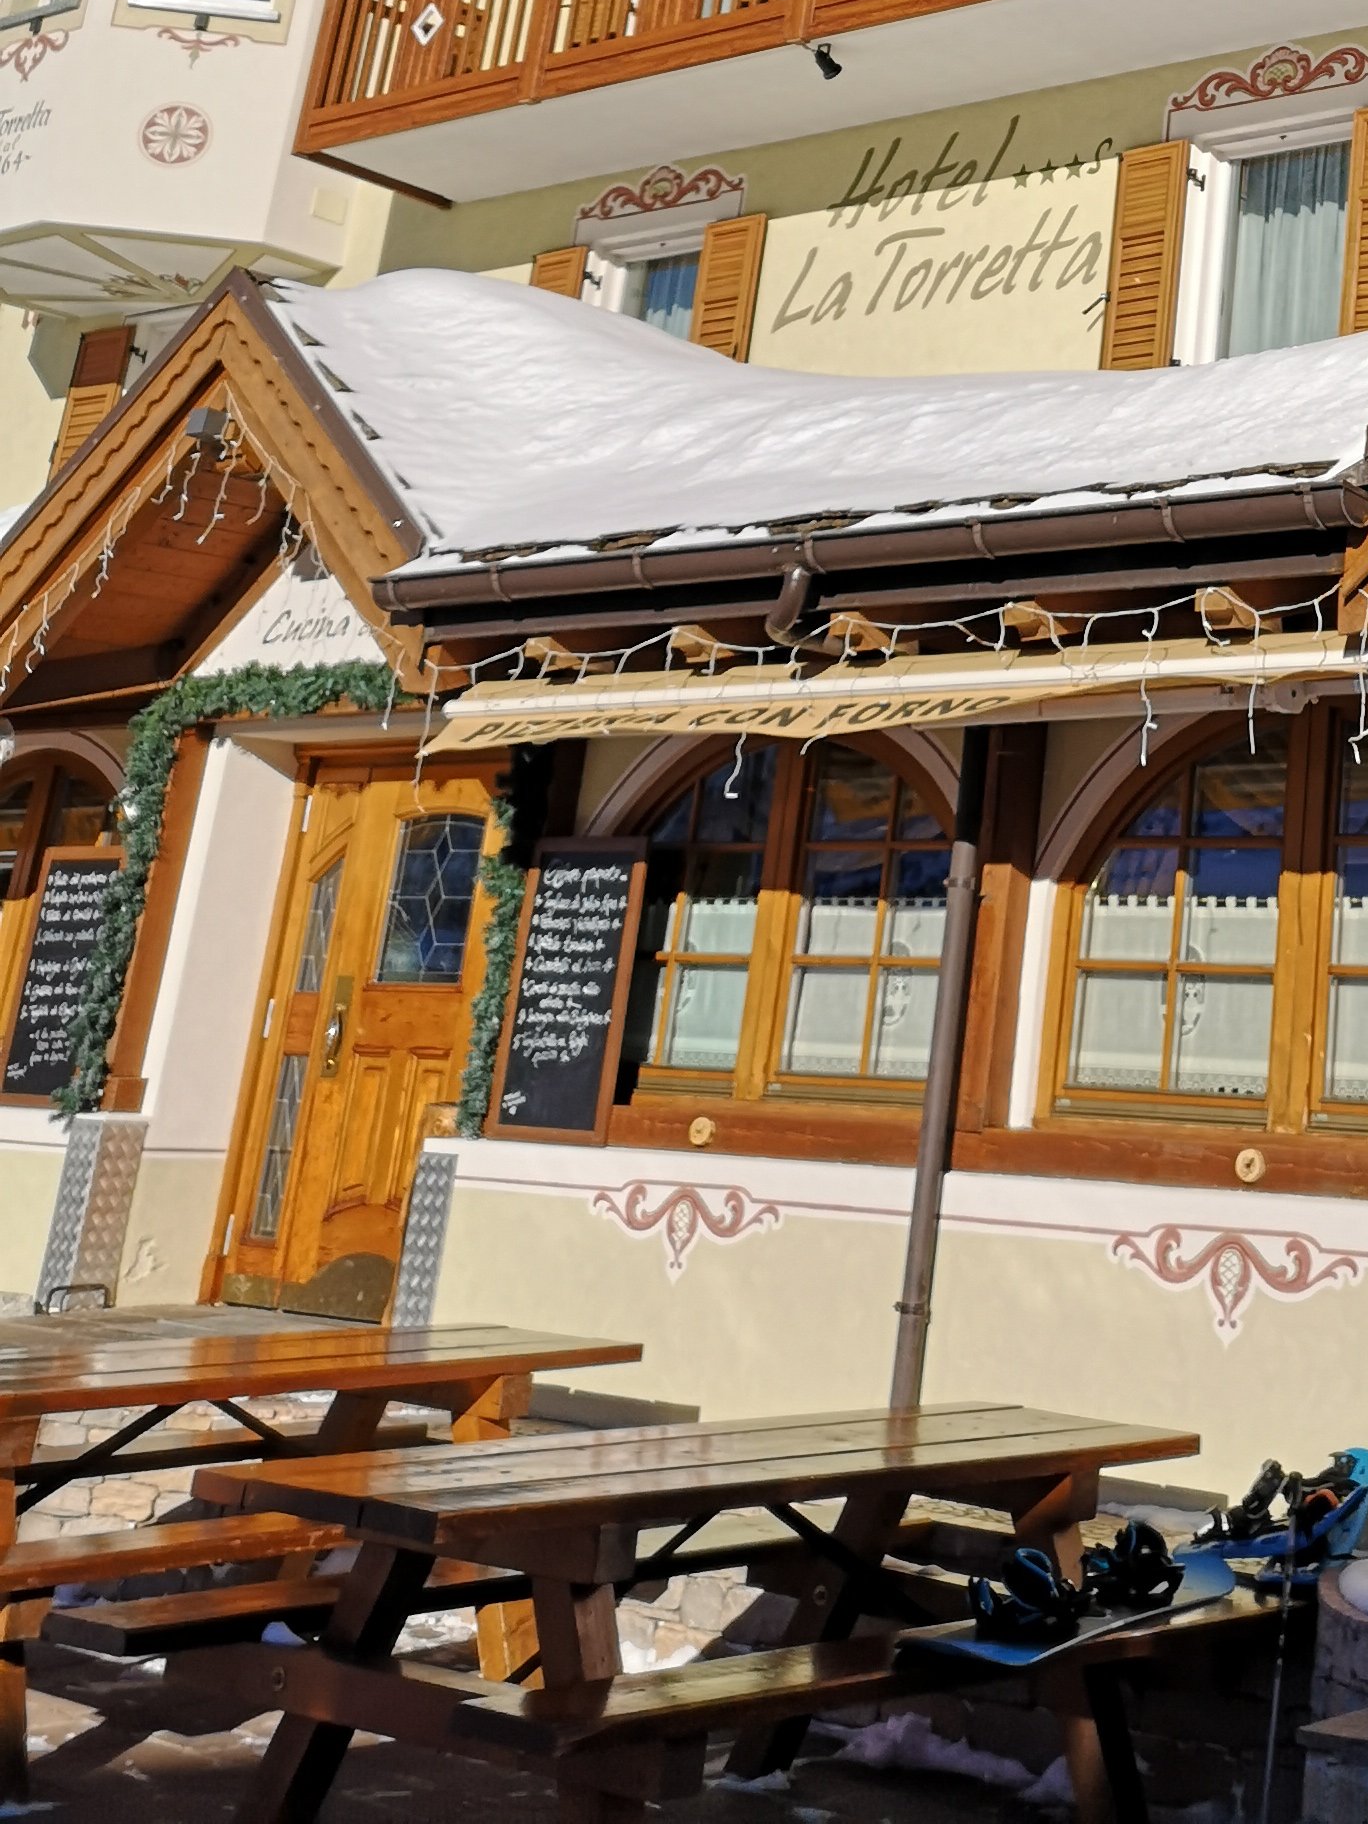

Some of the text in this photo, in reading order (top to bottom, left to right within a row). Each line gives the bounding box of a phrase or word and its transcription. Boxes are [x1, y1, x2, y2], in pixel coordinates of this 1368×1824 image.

[826, 114, 1020, 230] Hotel
[770, 204, 1104, 334] La Torretta
[261, 607, 351, 645] Cucina
[690, 704, 811, 728] CON
[813, 695, 1011, 728] FORNO
